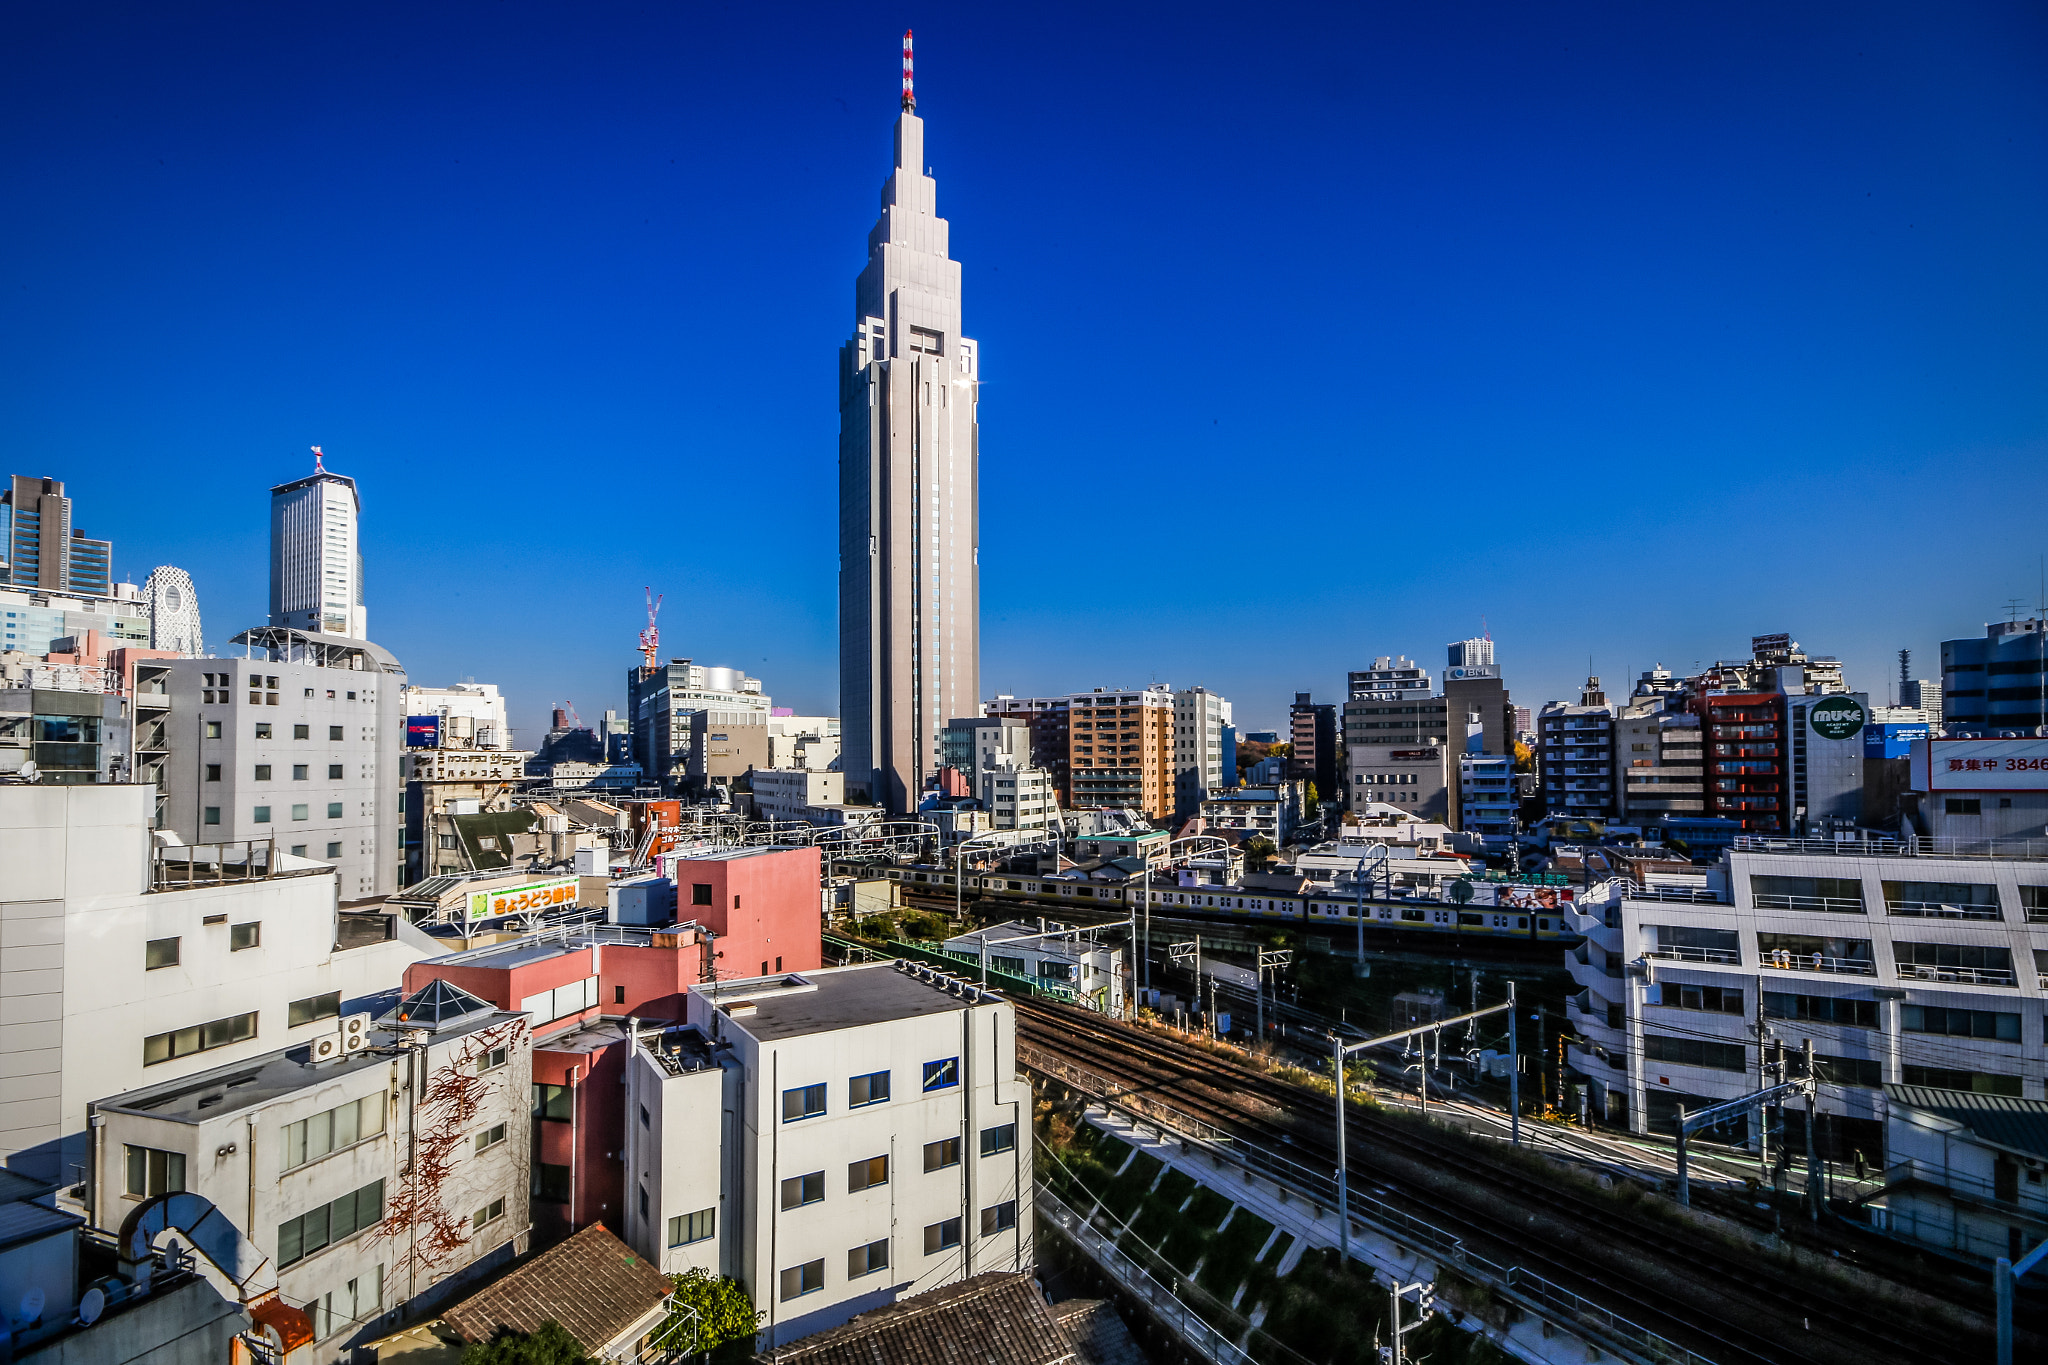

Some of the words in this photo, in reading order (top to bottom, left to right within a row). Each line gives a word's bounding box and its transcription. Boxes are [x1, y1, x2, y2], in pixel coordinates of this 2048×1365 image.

[1467, 668, 1492, 677] BML
[1949, 759, 1978, 772] 募集中
[494, 885, 577, 915] きょうどう歯科
